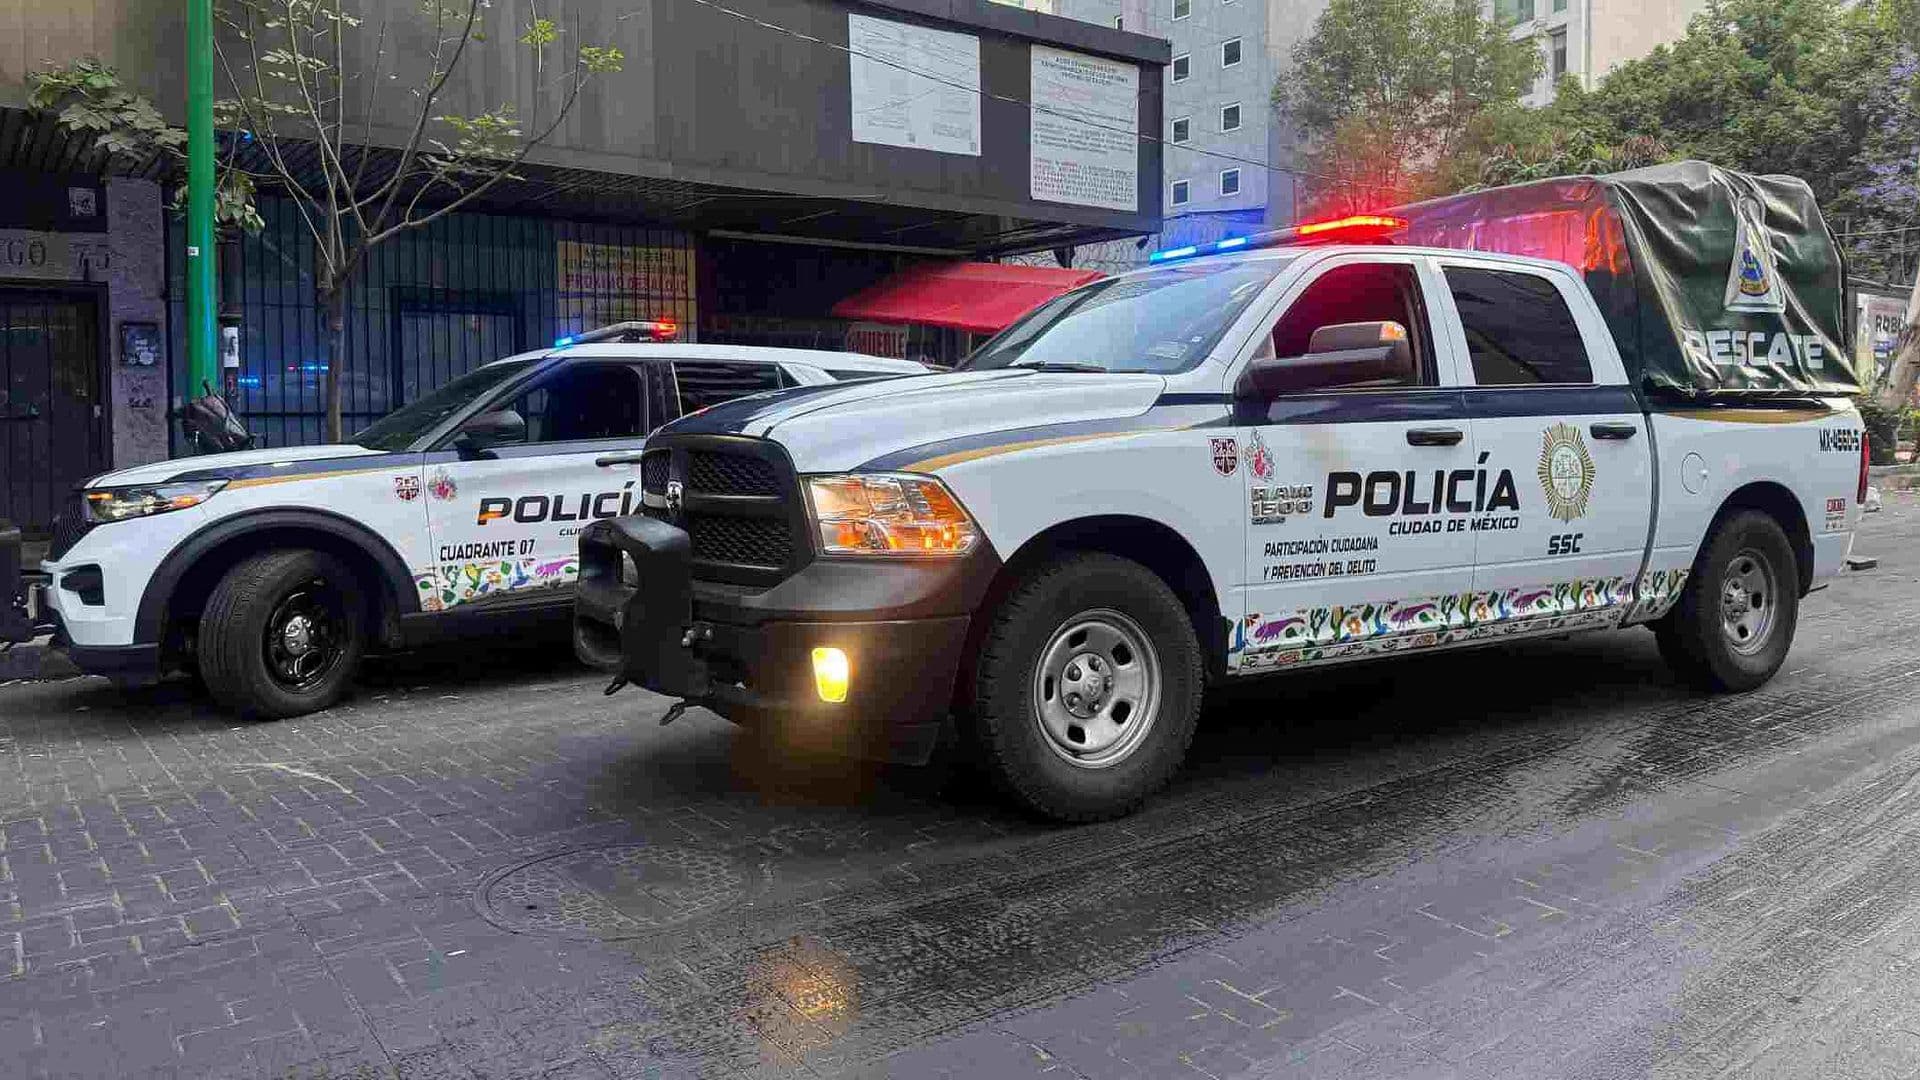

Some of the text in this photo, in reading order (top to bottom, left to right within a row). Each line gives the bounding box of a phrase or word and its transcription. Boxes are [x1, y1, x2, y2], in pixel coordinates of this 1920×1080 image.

[1324, 451, 1520, 518] POLICÍA
[477, 481, 635, 525] POLICÍ
[1388, 512, 1519, 535] CIUDAD DE MÉXICO
[440, 539, 536, 562] CUADRANTE 07
[1264, 534, 1378, 556] PARTICIPACIÓN CIUDADANA
[1547, 533, 1584, 555] SSC
[1263, 557, 1377, 580] Y PREVENCIÓN DEL DELITO
